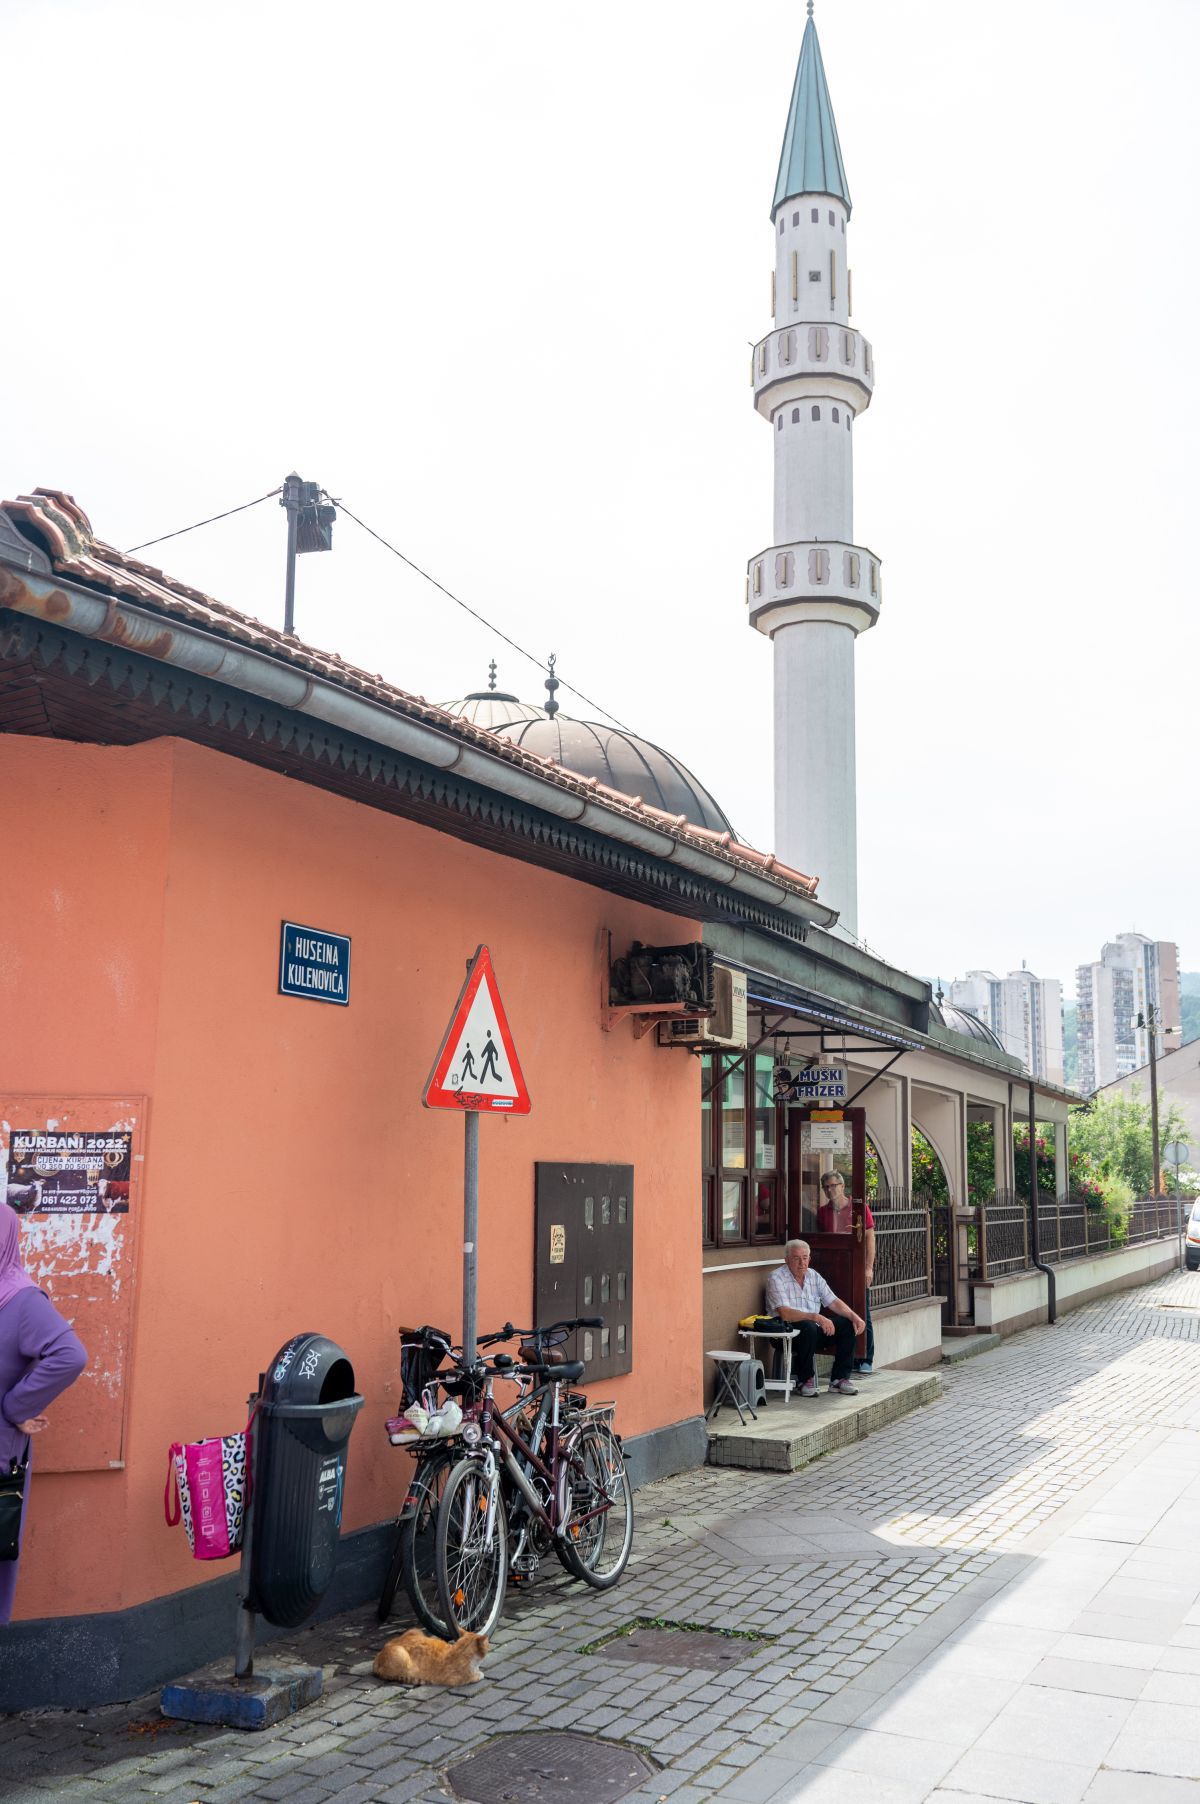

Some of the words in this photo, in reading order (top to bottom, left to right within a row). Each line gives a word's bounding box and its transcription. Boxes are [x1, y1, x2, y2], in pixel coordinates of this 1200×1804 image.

[295, 936, 339, 966] HUSEINA
[287, 963, 344, 994] KULENOVIĆA
[799, 1066, 843, 1082] MUŠKI
[797, 1084, 845, 1097] FRIZER
[13, 1136, 84, 1149] KURBANI
[87, 1138, 127, 1149] 2022.
[37, 1156, 63, 1164] CIJENA
[42, 1195, 58, 1204] 061
[60, 1195, 78, 1204] 422
[80, 1195, 97, 1204] 073
[319, 1467, 336, 1483] ALBA
